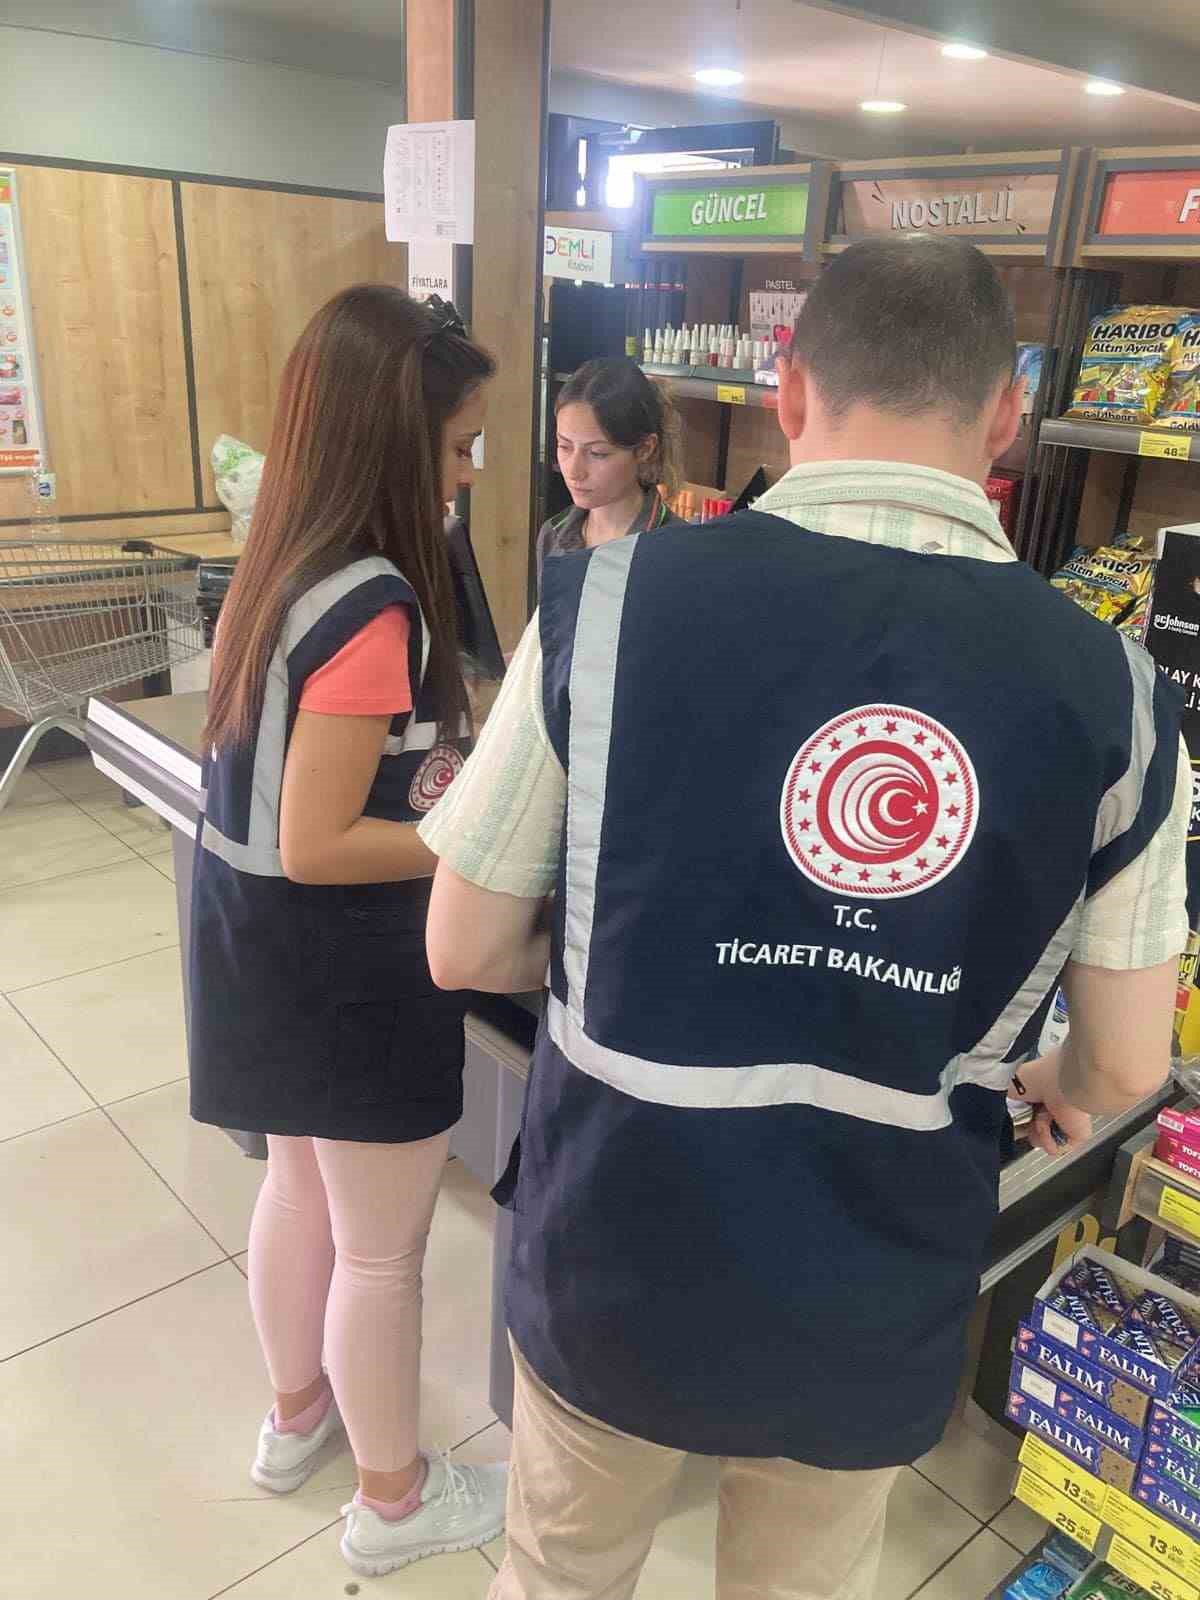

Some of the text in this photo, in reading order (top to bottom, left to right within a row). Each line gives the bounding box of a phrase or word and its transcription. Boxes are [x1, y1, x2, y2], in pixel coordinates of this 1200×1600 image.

[691, 191, 768, 226] GÜNCEL
[890, 185, 1016, 231] NOSTALJİ
[765, 279, 797, 290] PASTEL
[1093, 322, 1177, 341] HARIBO
[833, 904, 878, 932] T.C.
[715, 938, 823, 967] TİCARET
[1039, 1345, 1104, 1396] FALIM
[1099, 1346, 1157, 1388] FALIM
[1028, 1410, 1094, 1461] FALIM
[1075, 1407, 1130, 1449] FALIM
[1063, 1478, 1081, 1498] 13
[1055, 1512, 1077, 1534] 25
[1149, 1534, 1168, 1555] 13
